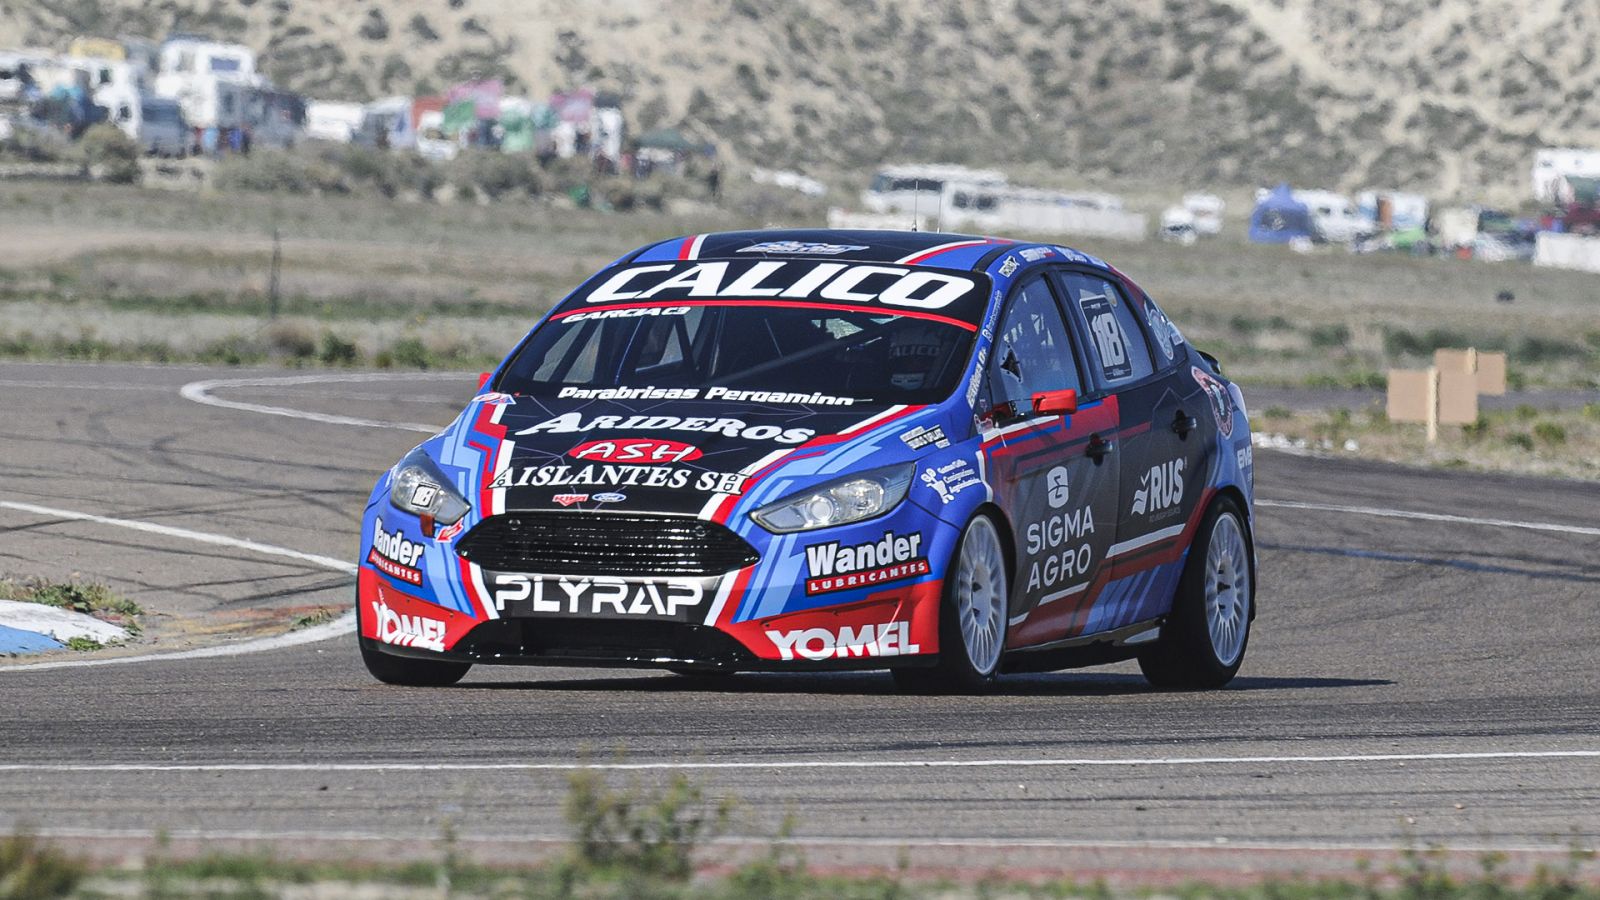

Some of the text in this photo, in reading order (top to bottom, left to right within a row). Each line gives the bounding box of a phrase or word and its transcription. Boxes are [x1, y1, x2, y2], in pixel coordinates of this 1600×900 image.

[586, 261, 975, 309] CALICO
[561, 307, 661, 324] GARCIA
[557, 385, 700, 400] Parabrisas
[576, 441, 697, 463] ASH
[488, 464, 750, 495] AISLANTES SH
[1150, 458, 1184, 512] RUS
[1027, 505, 1095, 556] SIGMA
[806, 532, 921, 578] Wander
[1026, 543, 1092, 594] AGRO
[495, 575, 704, 616] PLYRAP
[810, 562, 927, 592] LUBRICANTES
[371, 601, 446, 653] YOMEL
[765, 620, 920, 661] YOMEL
